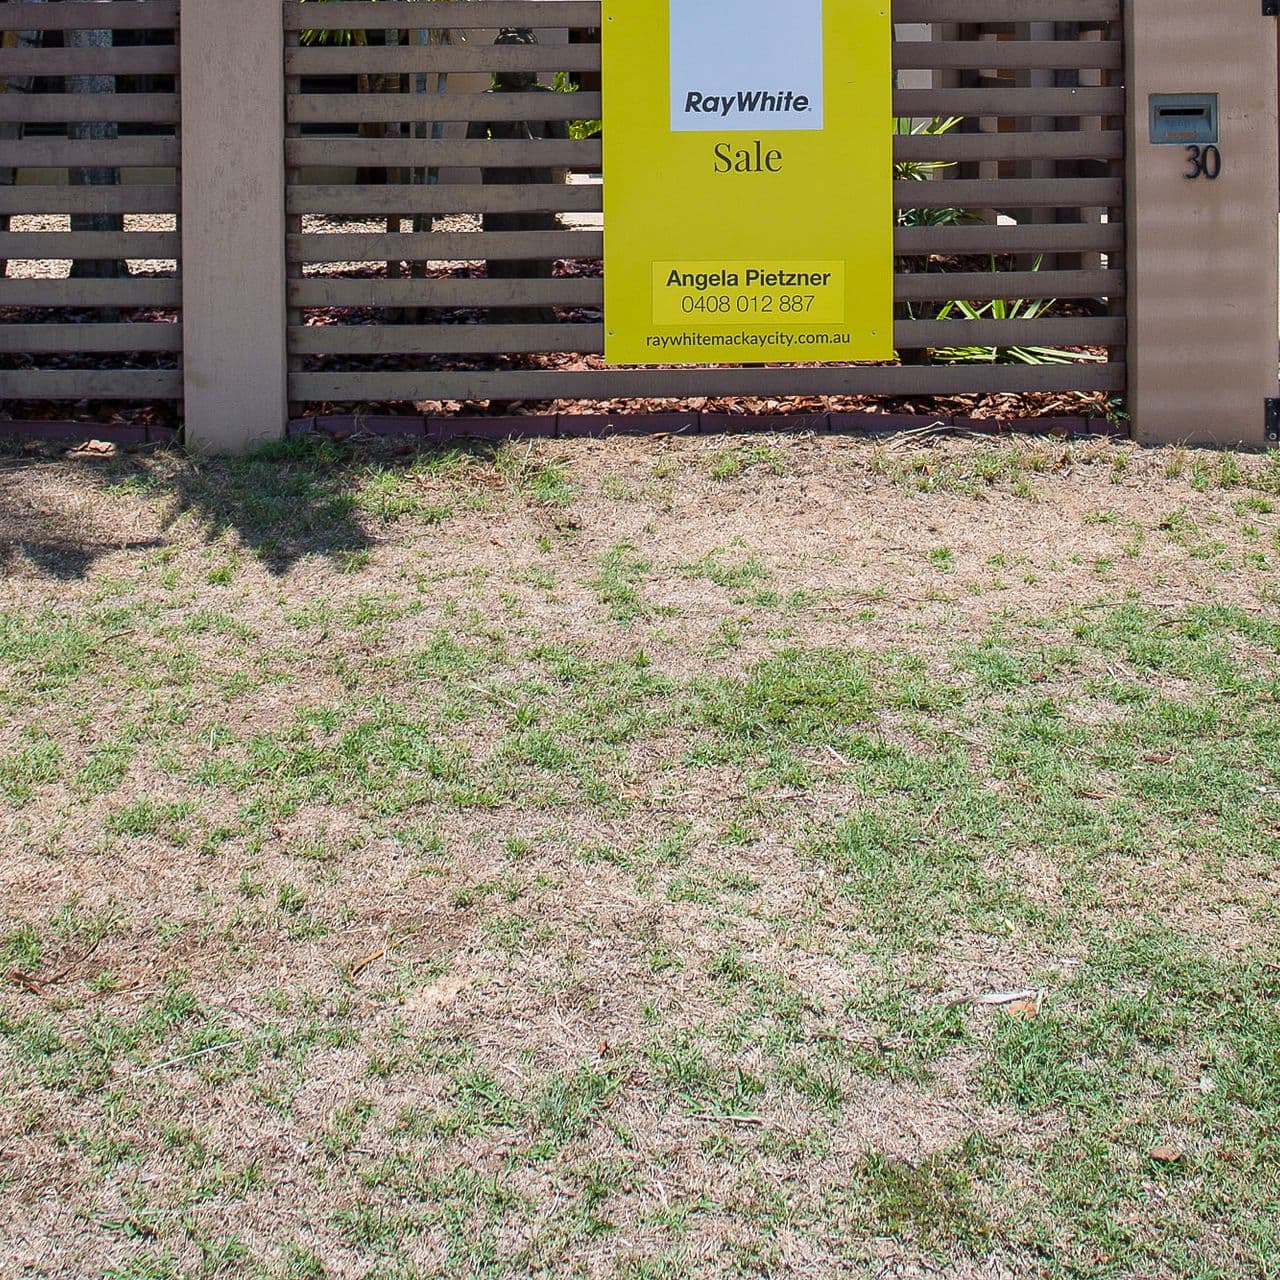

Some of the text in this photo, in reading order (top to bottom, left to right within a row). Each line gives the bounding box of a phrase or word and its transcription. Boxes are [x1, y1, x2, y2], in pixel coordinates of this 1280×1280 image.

[713, 140, 783, 173] Sale
[1183, 144, 1221, 179] 30
[666, 269, 831, 290] Angela Pietzner
[681, 295, 816, 313] 0408 012 887
[646, 331, 851, 348] raywhitemackaycity.com.au
